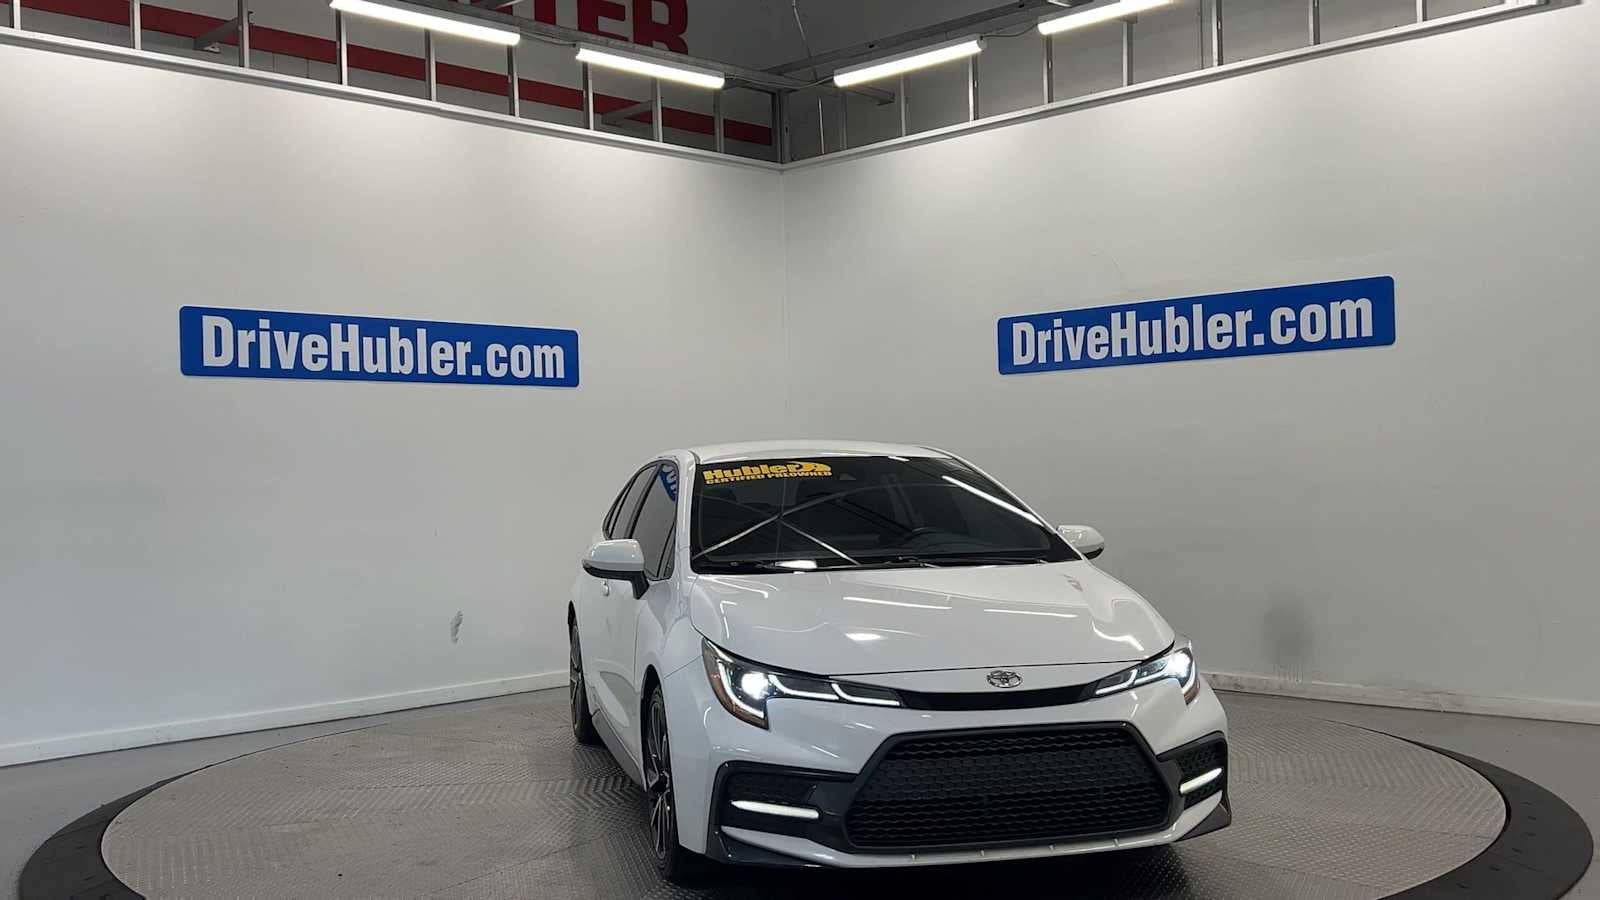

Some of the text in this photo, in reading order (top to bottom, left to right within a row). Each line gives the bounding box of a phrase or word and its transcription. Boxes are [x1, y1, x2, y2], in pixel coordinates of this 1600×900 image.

[202, 314, 566, 379] DriveHubler.com
[1012, 297, 1373, 367] DriveHubler.com
[703, 464, 800, 480] Hubler
